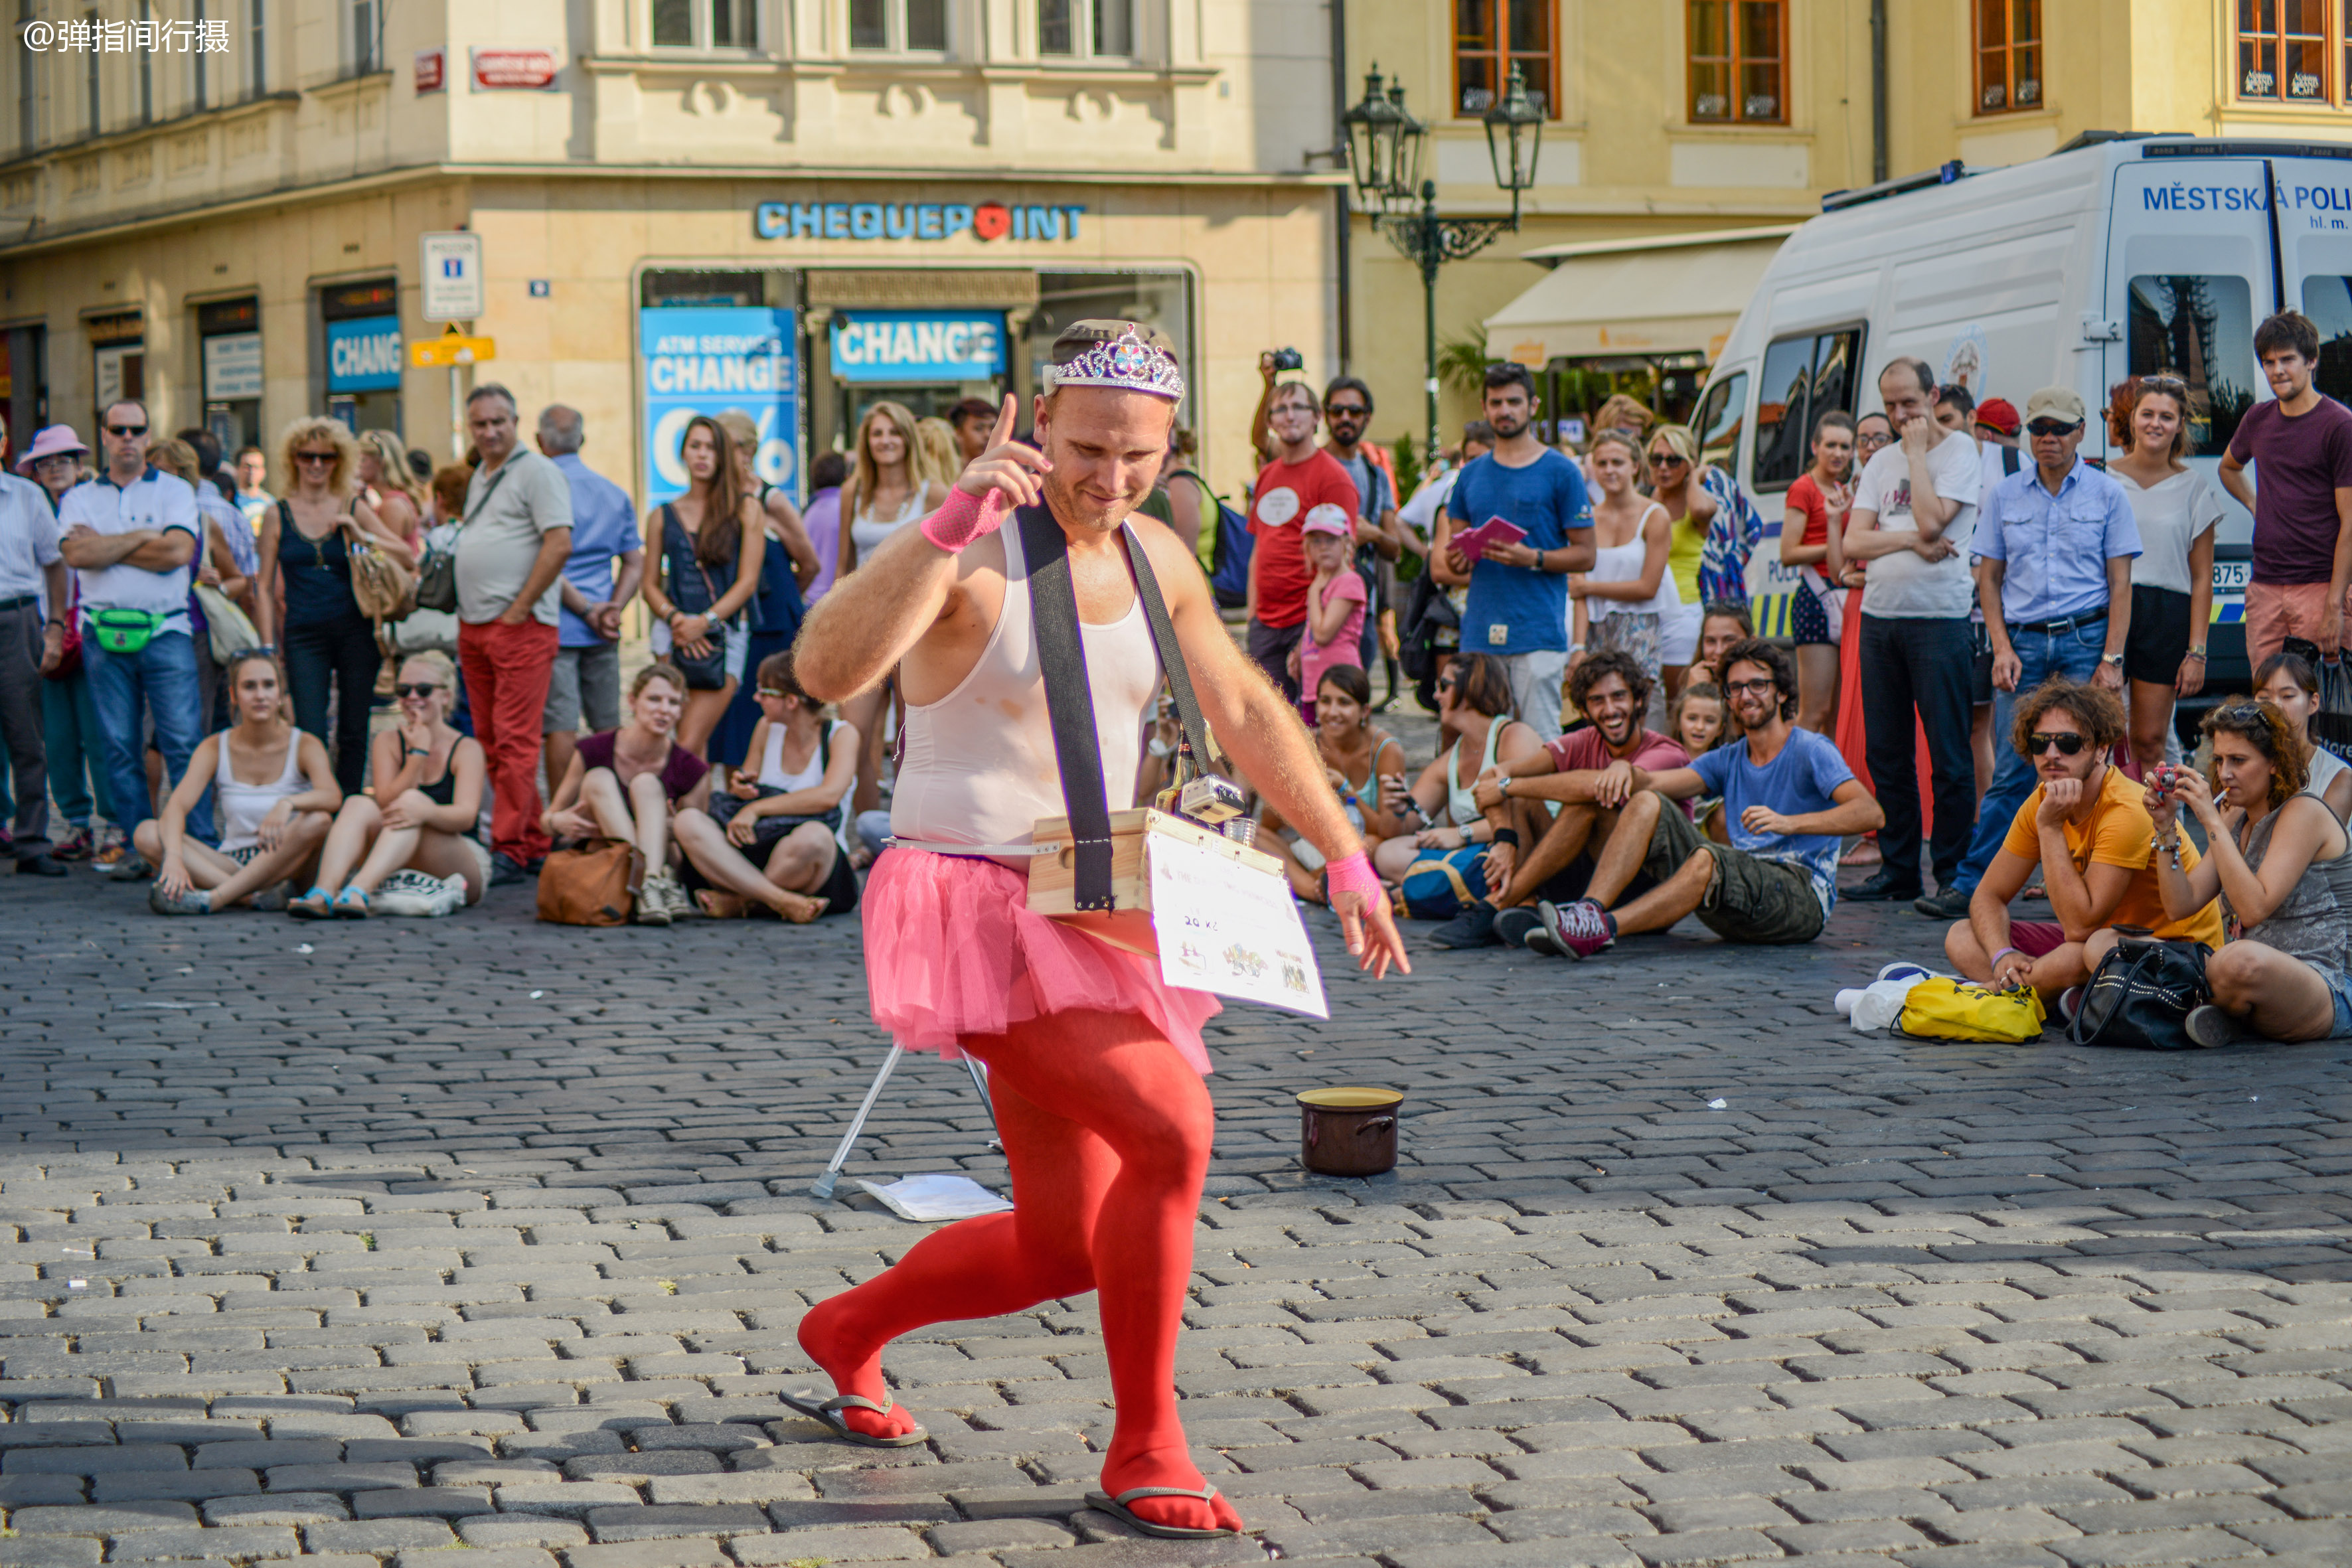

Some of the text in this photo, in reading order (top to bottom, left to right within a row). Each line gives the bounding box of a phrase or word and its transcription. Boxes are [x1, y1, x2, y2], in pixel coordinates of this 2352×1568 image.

[2143, 181, 2289, 210] MĚSTSKÁ
[756, 202, 1087, 240] CHEQUEPOINT
[2310, 216, 2348, 229] hl. m.
[332, 332, 401, 376] CHANG
[656, 335, 696, 354] ATM
[838, 321, 997, 363] CHANGE
[651, 355, 791, 392] CHANGE
[2213, 566, 2244, 584] 875
[1184, 915, 1200, 928] 20
